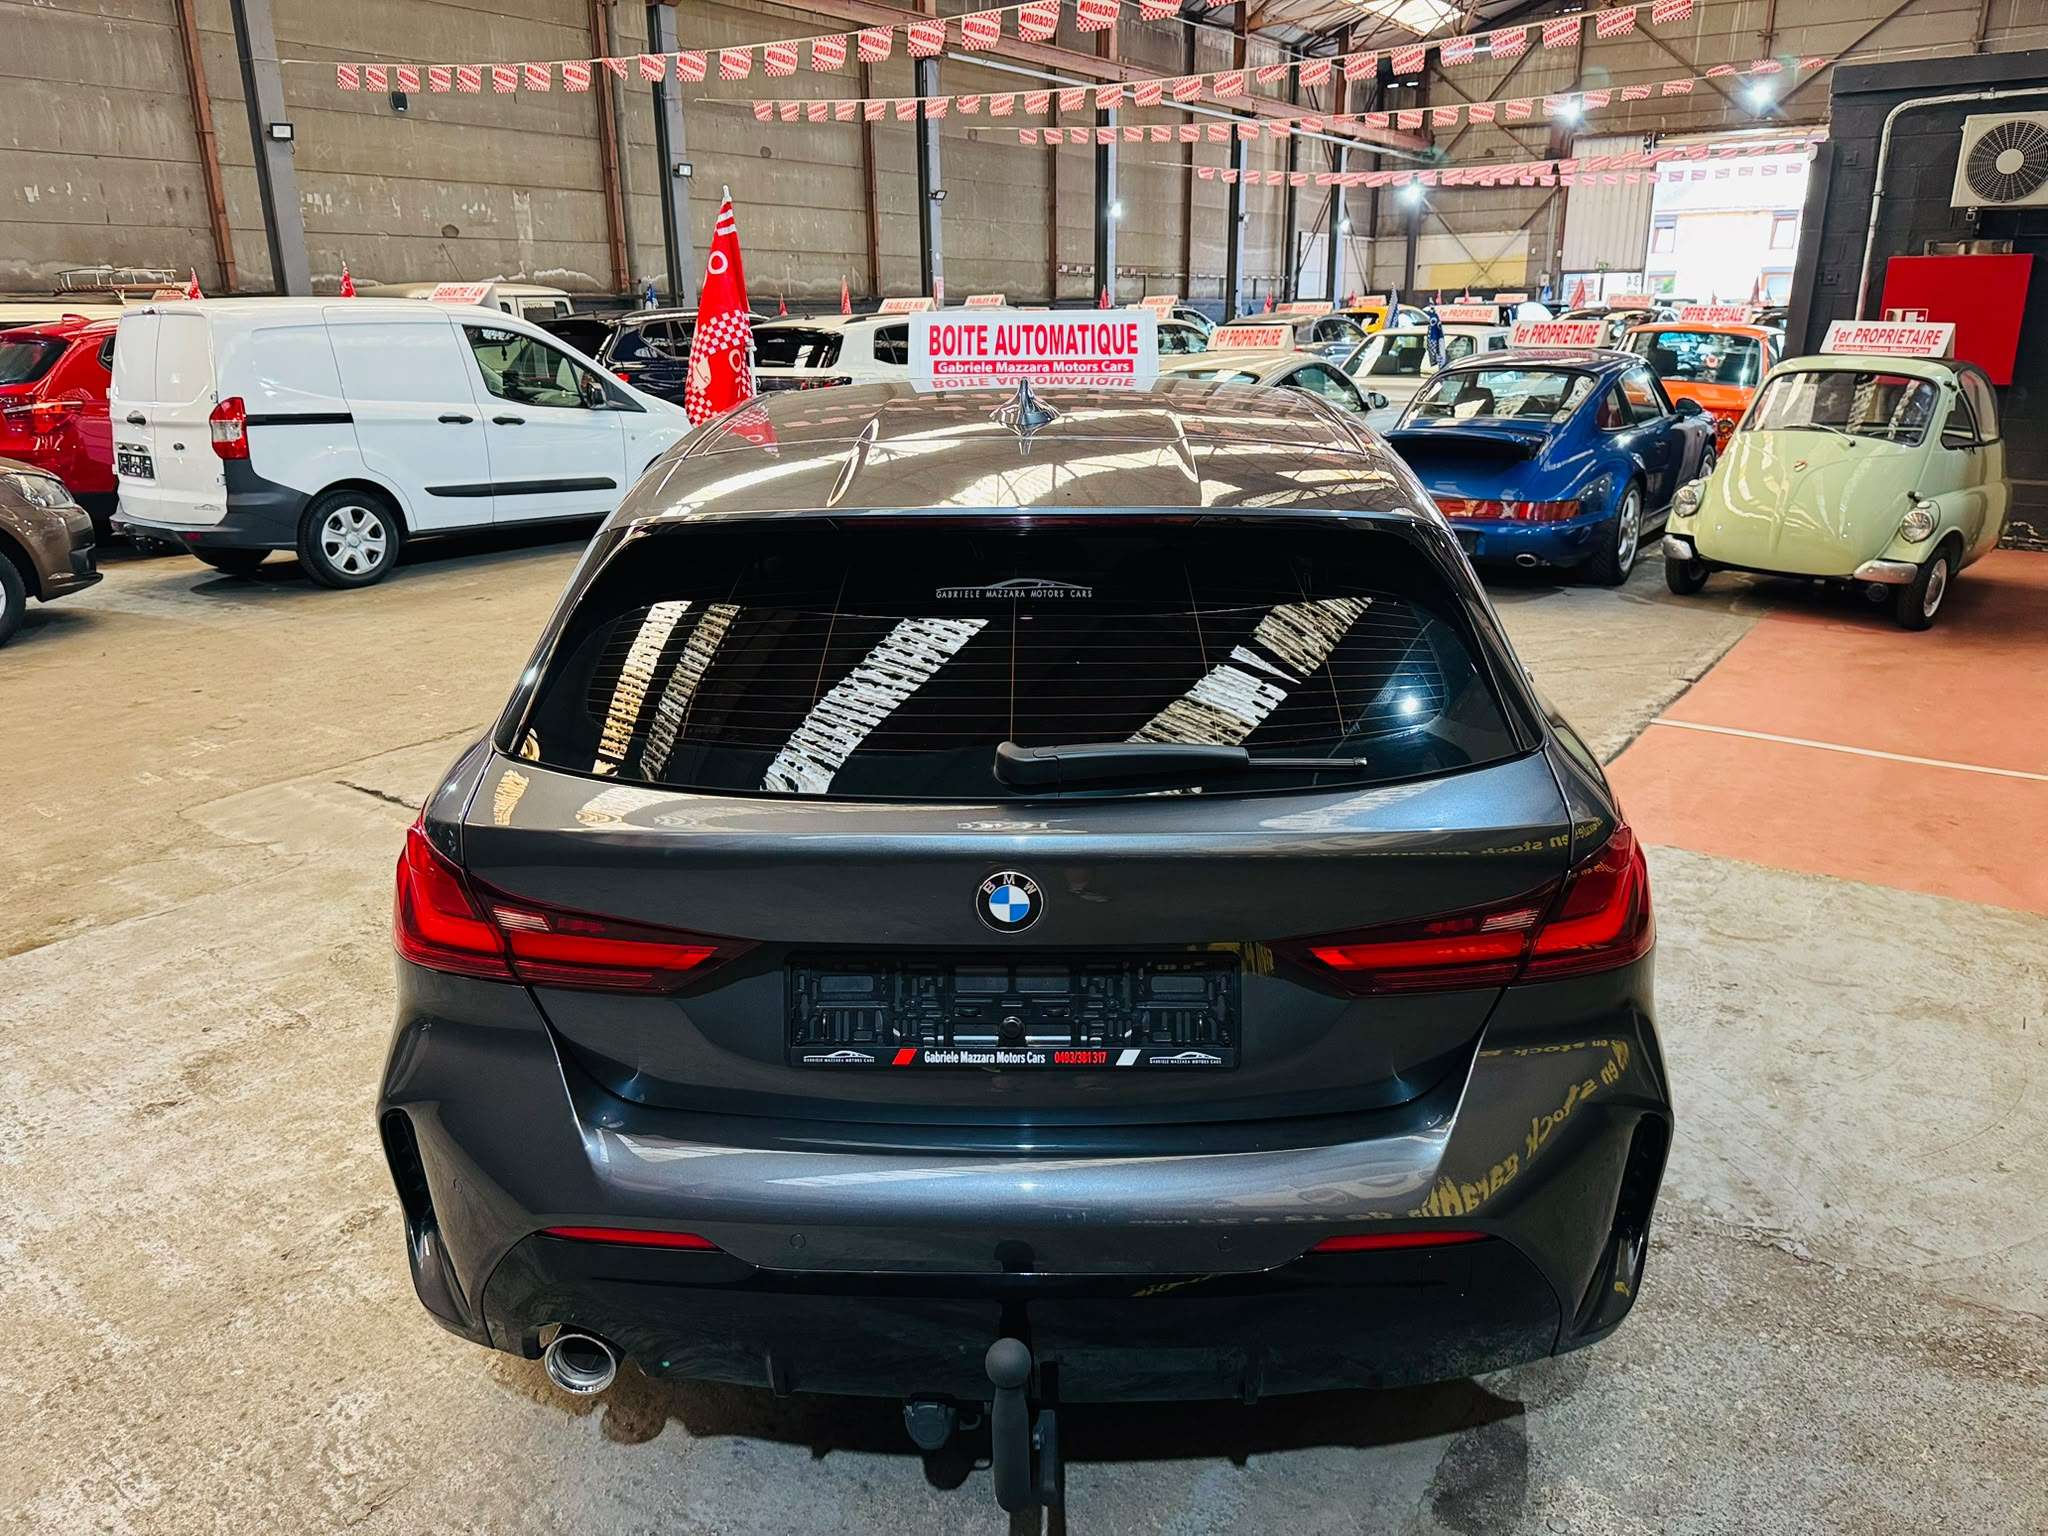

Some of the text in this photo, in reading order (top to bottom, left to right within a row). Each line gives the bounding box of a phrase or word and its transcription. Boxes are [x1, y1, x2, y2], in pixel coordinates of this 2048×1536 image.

[1680, 307, 1746, 322] OFFRE SPECIALE
[929, 323, 1139, 357] BOITE AUTOMATIQUE
[1514, 323, 1600, 346] 1er PROPRIETAIRE
[1833, 327, 1943, 345] 1er PROPRIETAIRE
[938, 361, 1130, 373] Gabriele Mazzara Motors Cars
[936, 590, 1093, 599] GABRIELE MAZZARA MOTORS CARS
[982, 873, 1038, 895] BMW
[924, 1050, 959, 1064] Gabriele
[960, 1051, 995, 1064] Mazzara
[996, 1051, 1026, 1064] Motors
[1027, 1051, 1046, 1064] Cars
